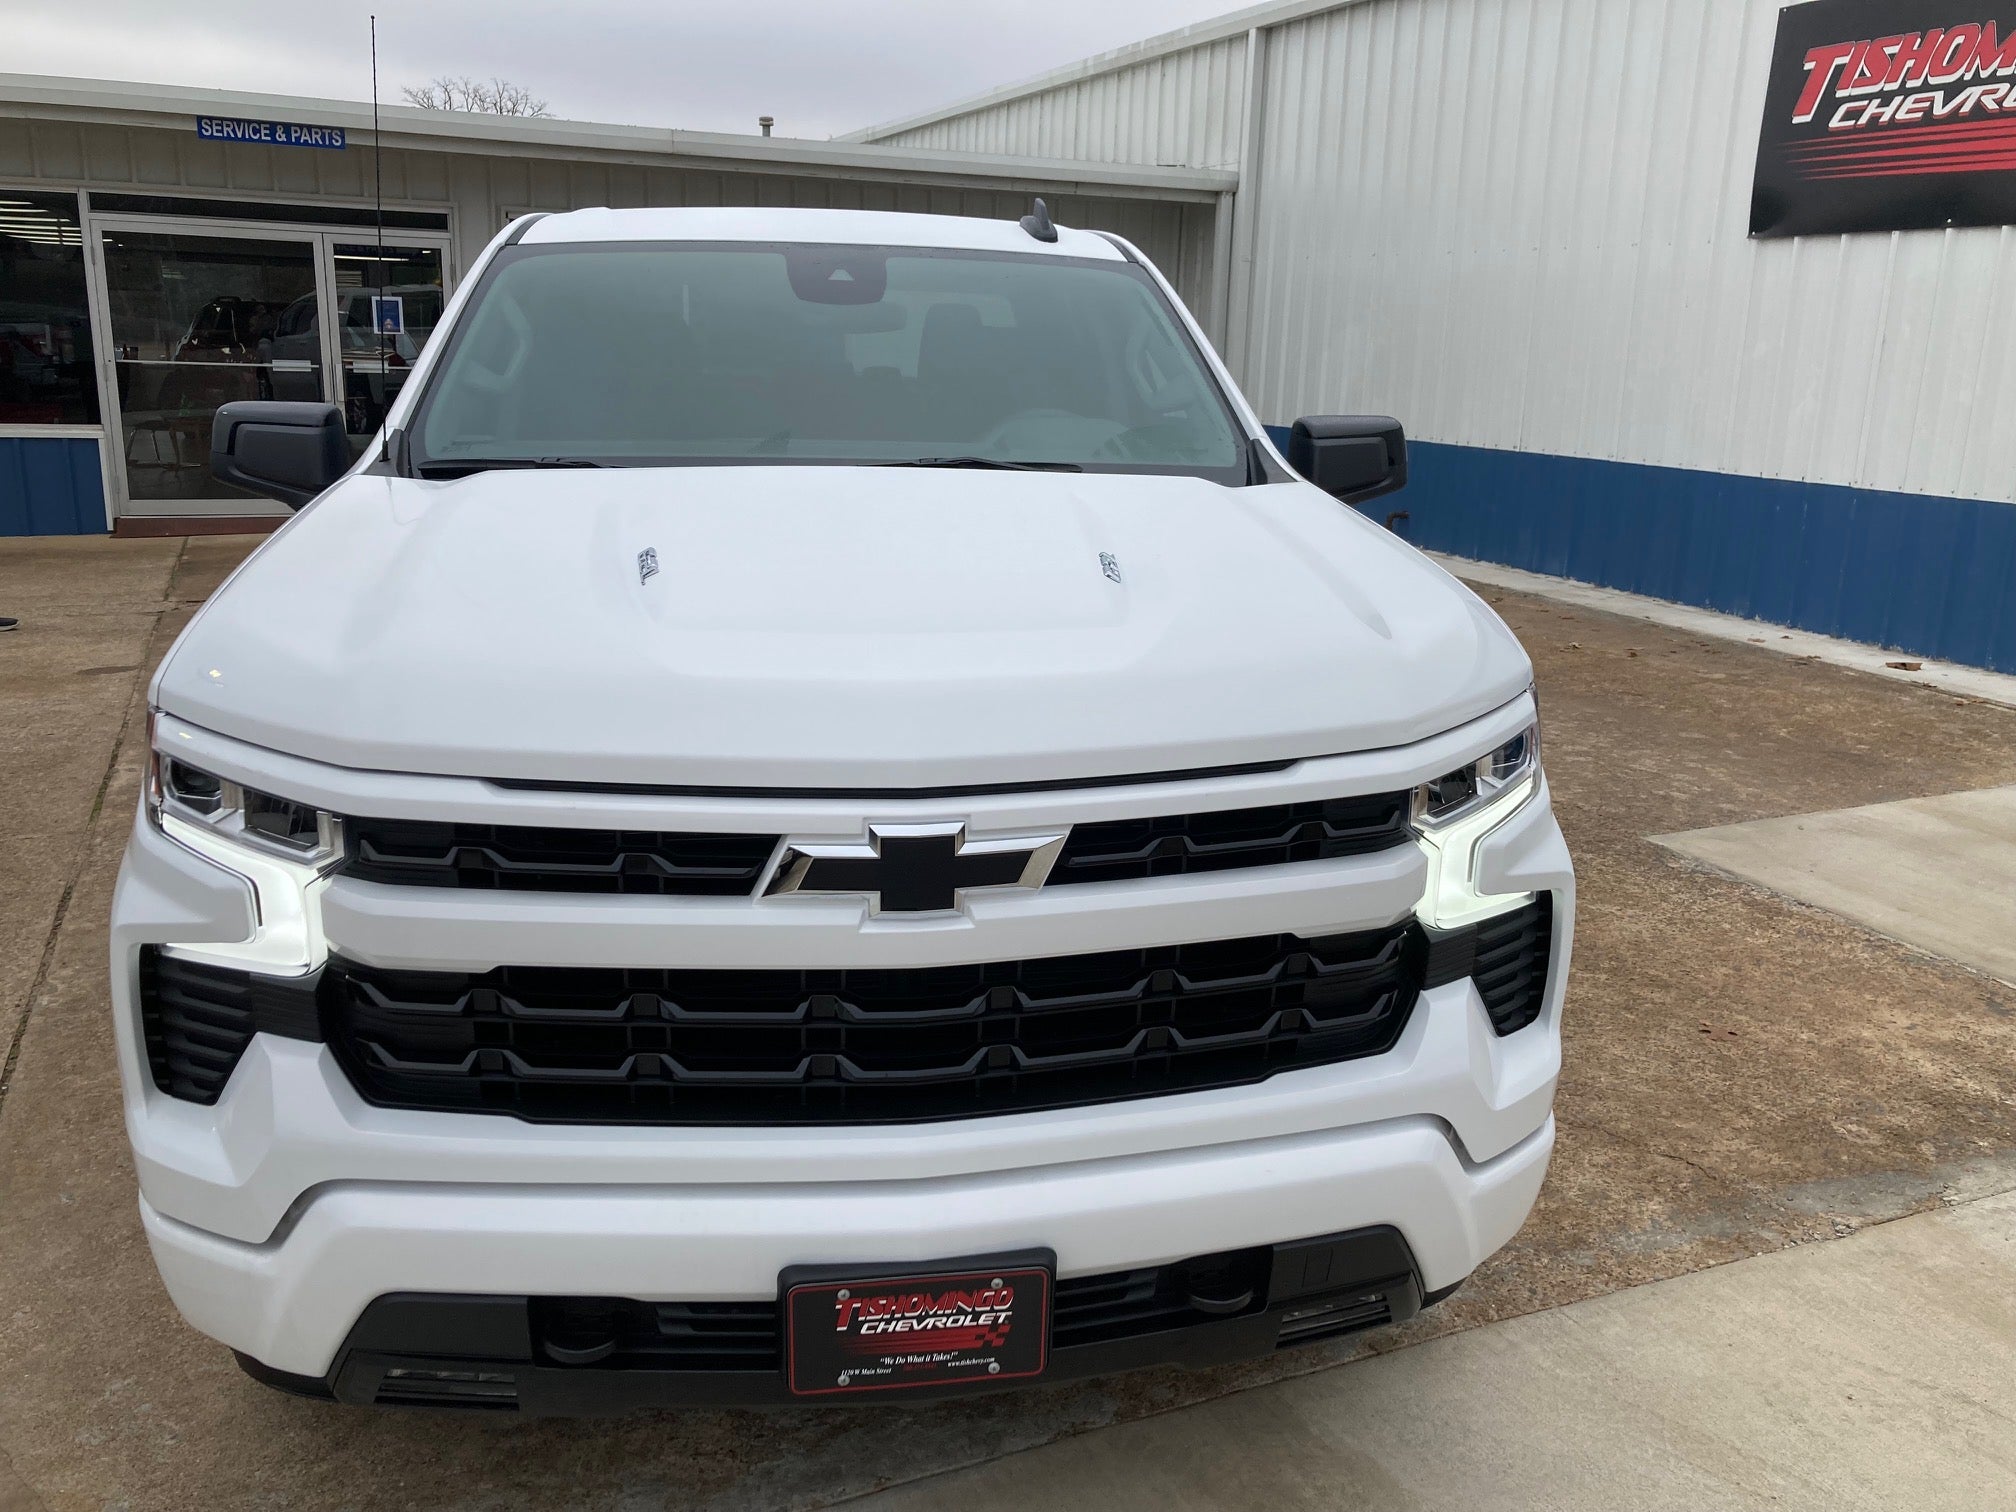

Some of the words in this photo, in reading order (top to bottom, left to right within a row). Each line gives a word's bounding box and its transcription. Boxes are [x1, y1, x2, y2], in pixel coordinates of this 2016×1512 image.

[201, 118, 271, 141] SERVICE
[275, 125, 287, 142] &
[291, 126, 342, 146] PARTS
[835, 1286, 1014, 1332] TISHOMINGO
[860, 1311, 1012, 1335] CHEVROLET
[861, 1367, 876, 1375] Main
[876, 1367, 892, 1375] Street
[895, 1356, 906, 1365] Do
[907, 1354, 925, 1364] What
